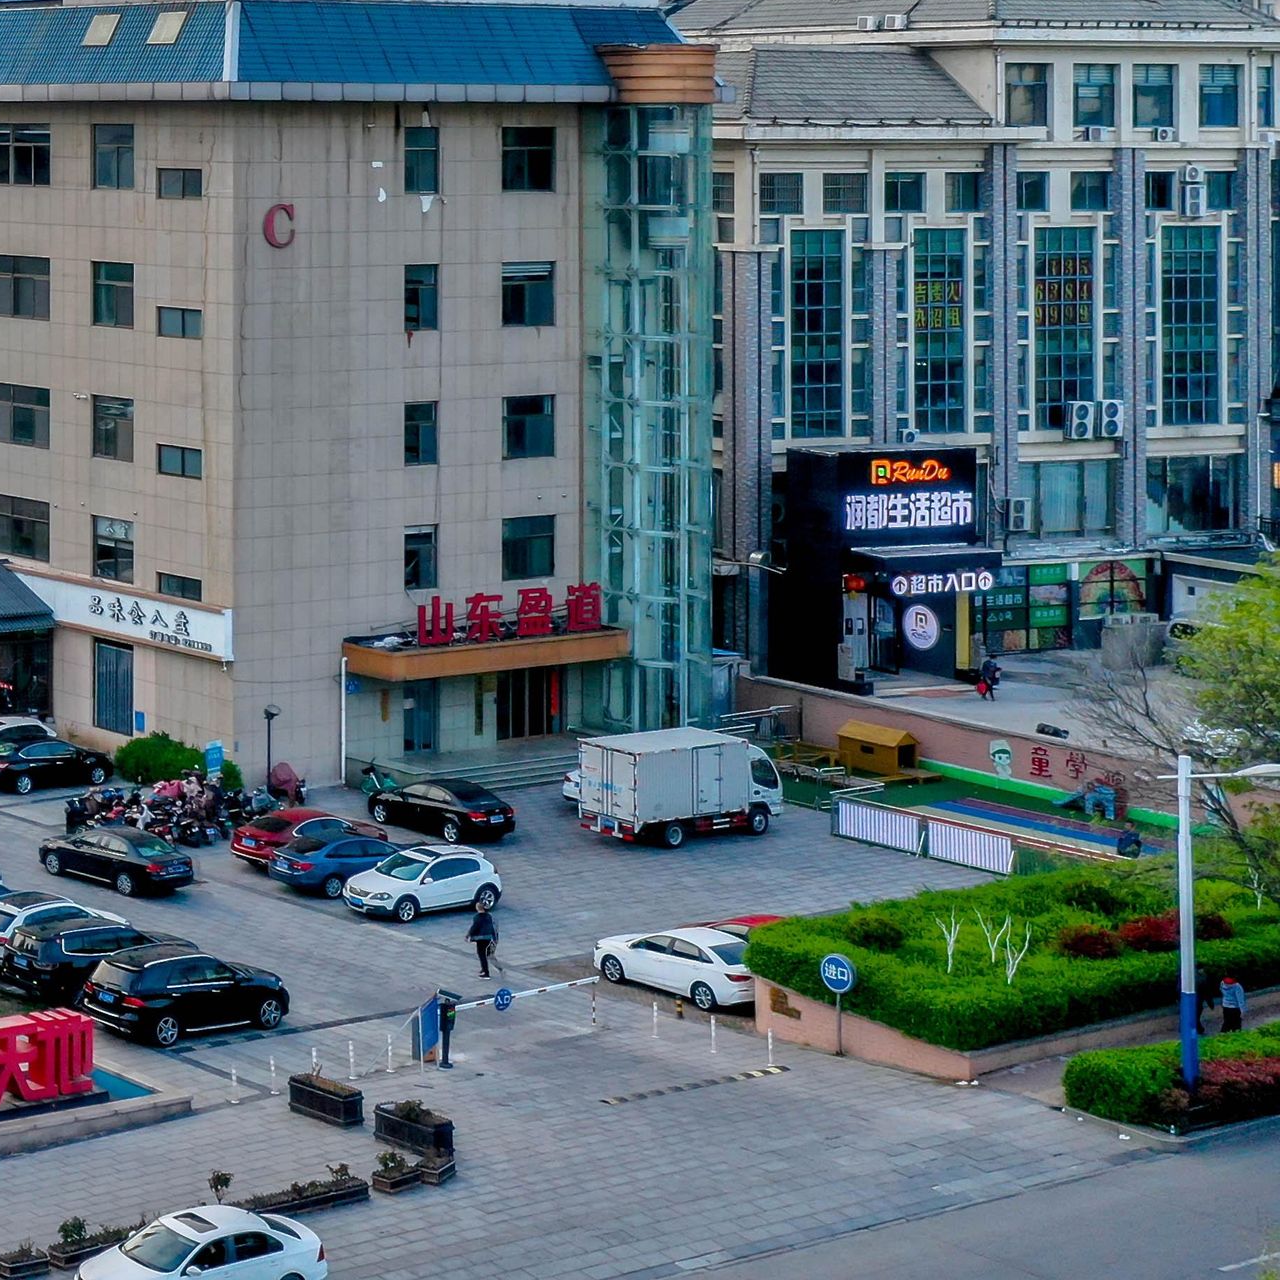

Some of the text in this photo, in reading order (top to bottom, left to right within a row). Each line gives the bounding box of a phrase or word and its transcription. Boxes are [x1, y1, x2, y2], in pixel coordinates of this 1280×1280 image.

[263, 203, 296, 249] C
[892, 459, 949, 483] RunDu
[845, 490, 973, 530] 润都生活超市
[910, 572, 976, 595] 超市入口
[825, 962, 848, 981] 进口
